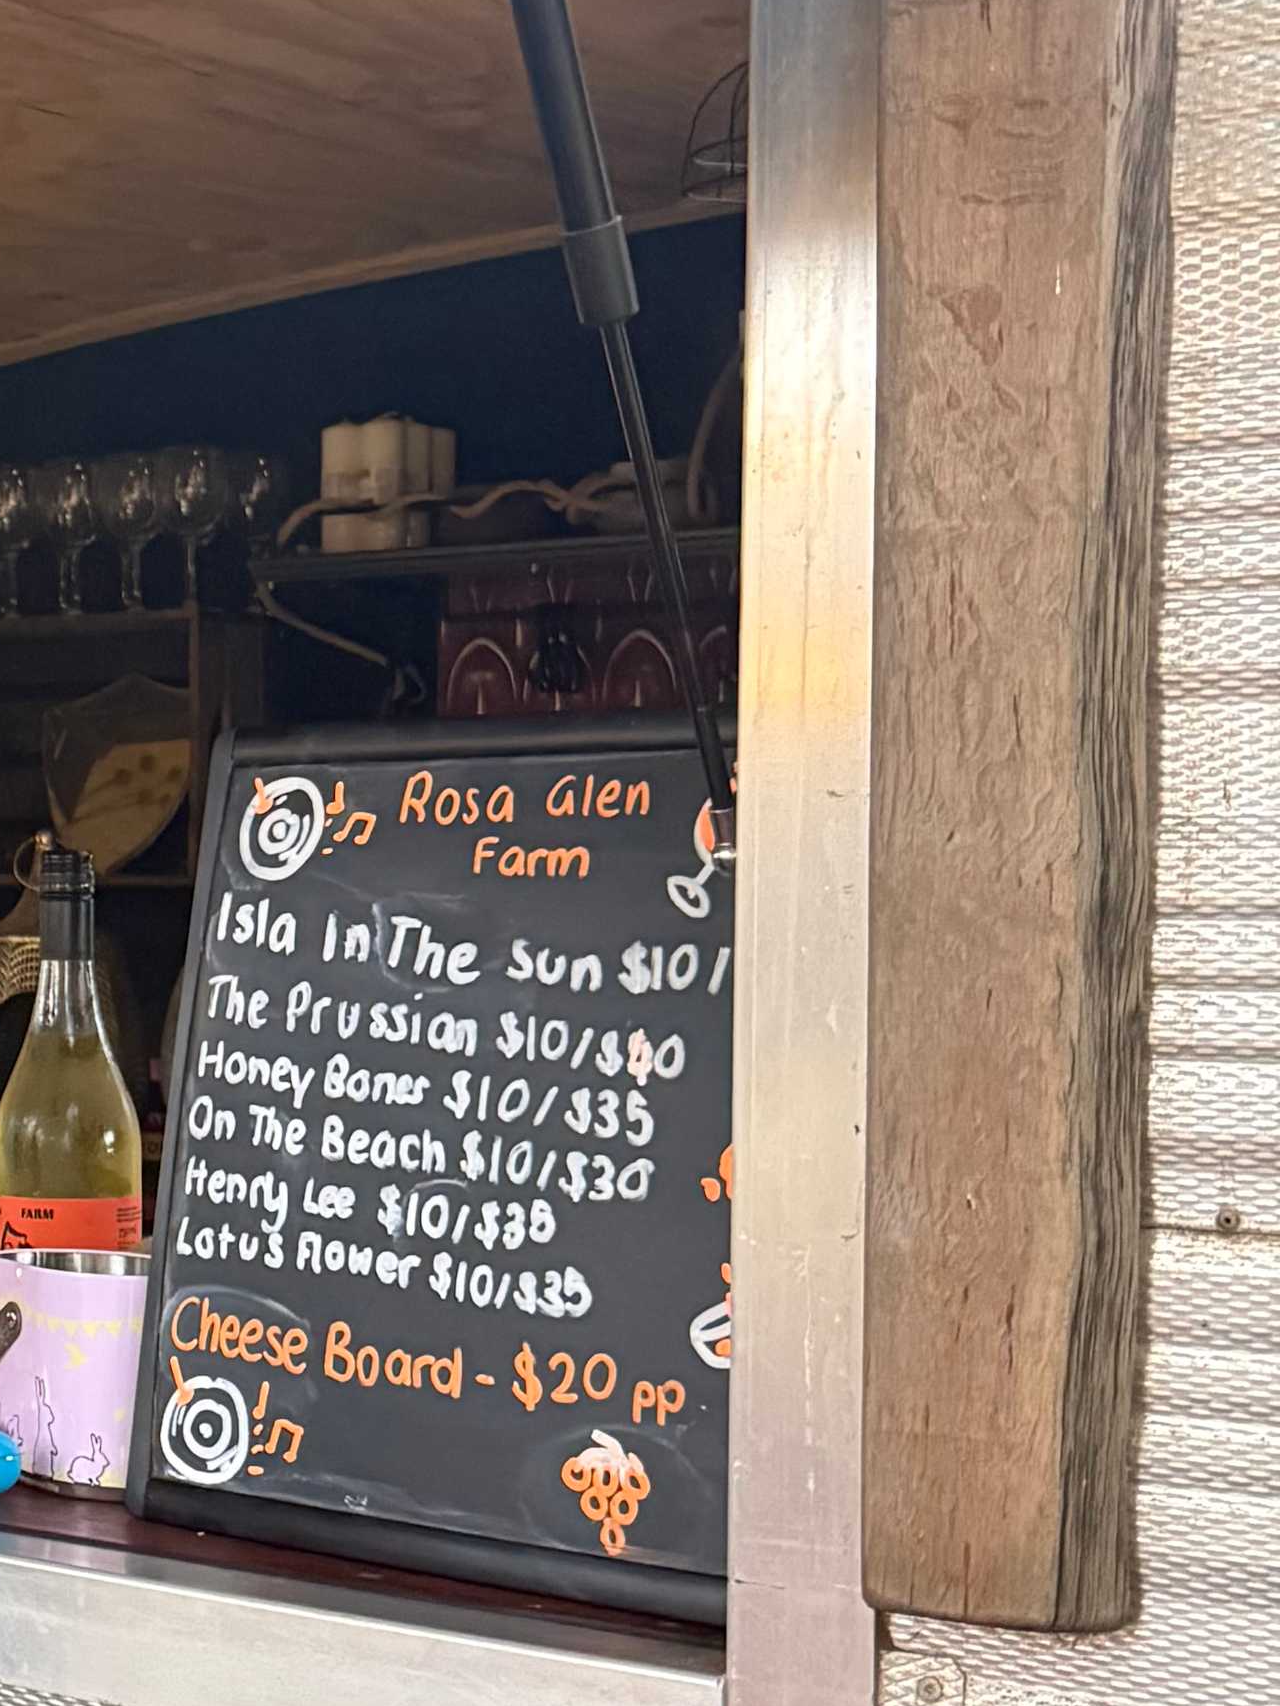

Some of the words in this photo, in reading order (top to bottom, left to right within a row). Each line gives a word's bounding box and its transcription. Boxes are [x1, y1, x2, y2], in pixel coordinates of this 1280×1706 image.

[399, 770, 515, 826] Rosa
[546, 774, 650, 818] Glen
[473, 836, 590, 878] Farm
[217, 891, 297, 956] Isla
[322, 911, 371, 963] In
[387, 915, 481, 985] The
[505, 939, 602, 993] Sun
[207, 974, 270, 1029] The
[286, 980, 478, 1057] Prussian
[197, 1040, 316, 1110] Honey
[323, 1052, 431, 1105] Bones
[189, 1095, 237, 1141] On
[248, 1104, 307, 1156] The
[320, 1114, 447, 1174] Beach
[20, 1207, 54, 1220] FARM
[184, 1155, 289, 1233] Henry
[302, 1177, 356, 1219] Lee
[176, 1216, 285, 1270] Lotus
[296, 1230, 422, 1289] Flower
[170, 1296, 308, 1375] Cheese
[324, 1320, 463, 1399] Board
[511, 1340, 618, 1412] $20
[631, 1378, 687, 1427] pp
